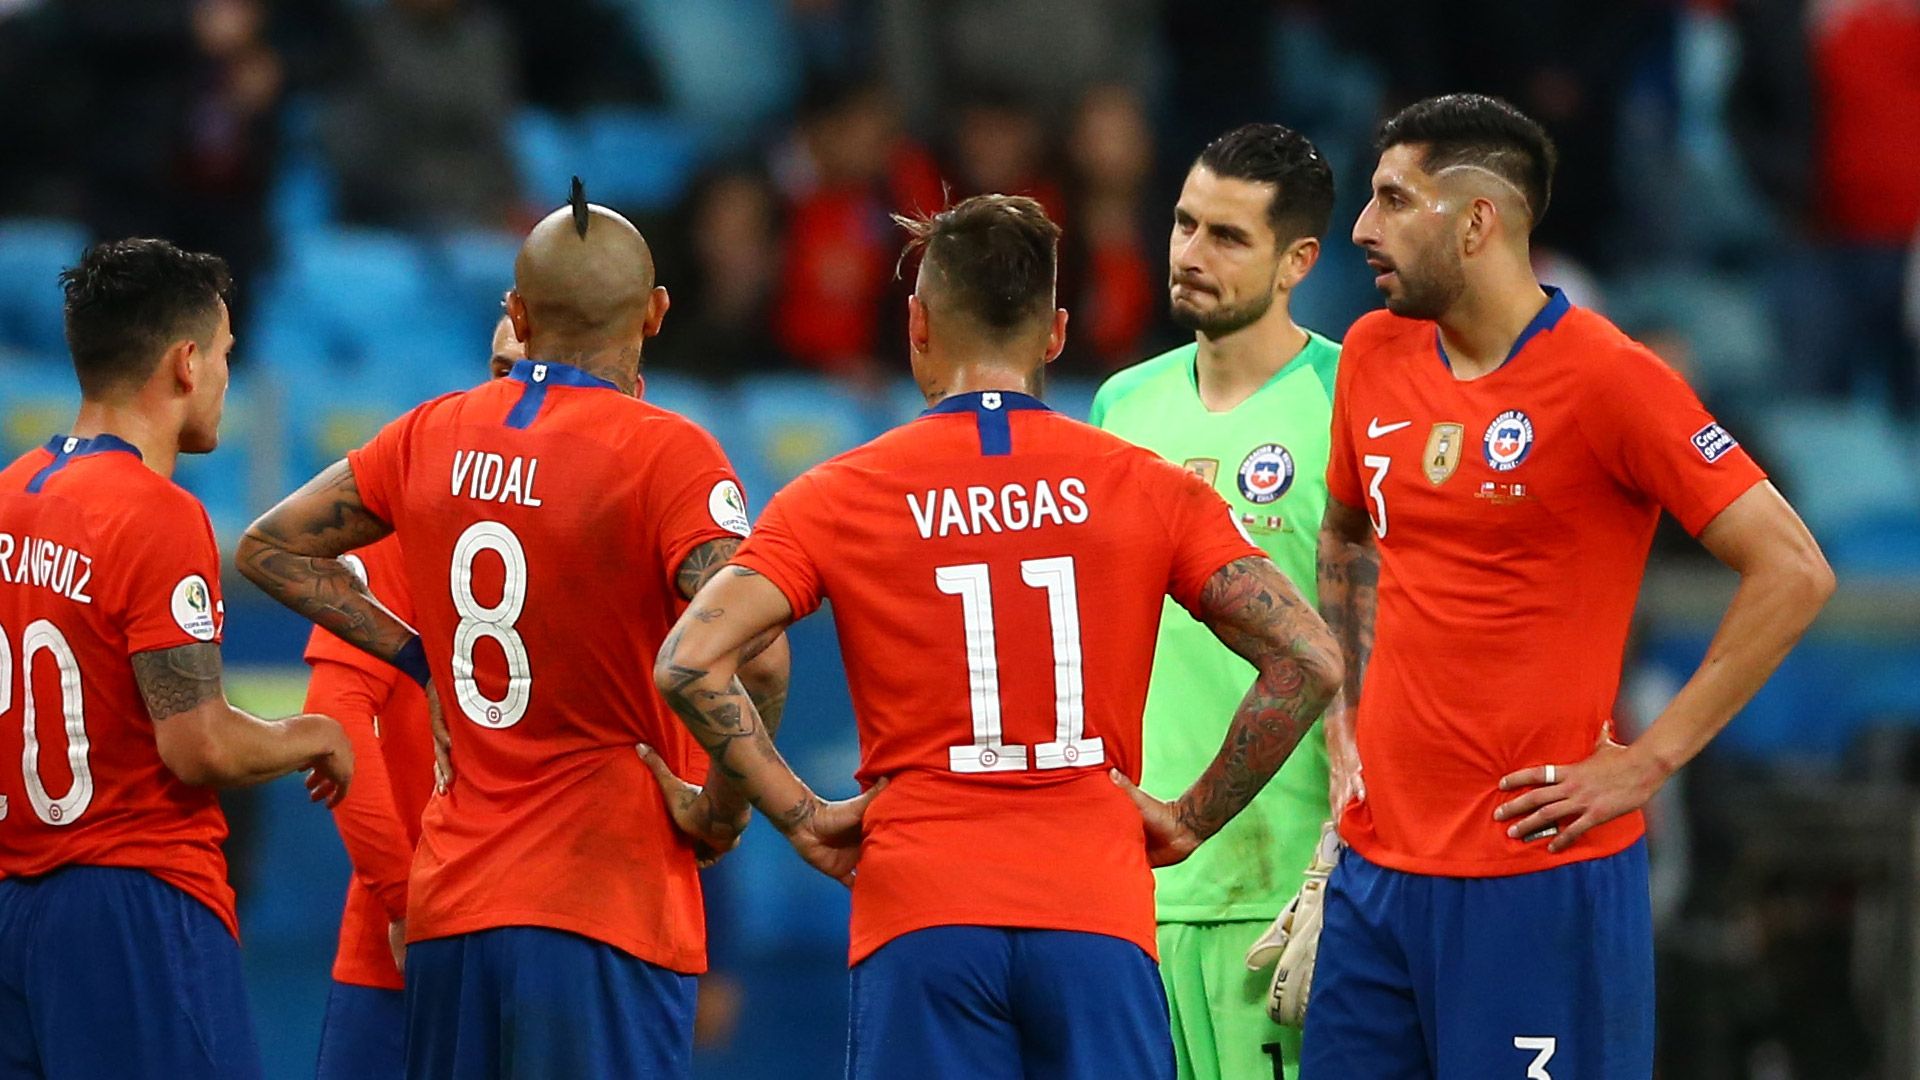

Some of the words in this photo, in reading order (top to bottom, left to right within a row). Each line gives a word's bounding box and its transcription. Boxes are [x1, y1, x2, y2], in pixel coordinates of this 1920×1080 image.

[450, 450, 543, 507] VIDAL
[906, 478, 1089, 539] VARGAS
[1363, 455, 1391, 539] 3
[450, 520, 532, 729] 8
[935, 556, 1106, 773] 11
[0, 619, 94, 826] 0
[1513, 1036, 1556, 1080] 3
